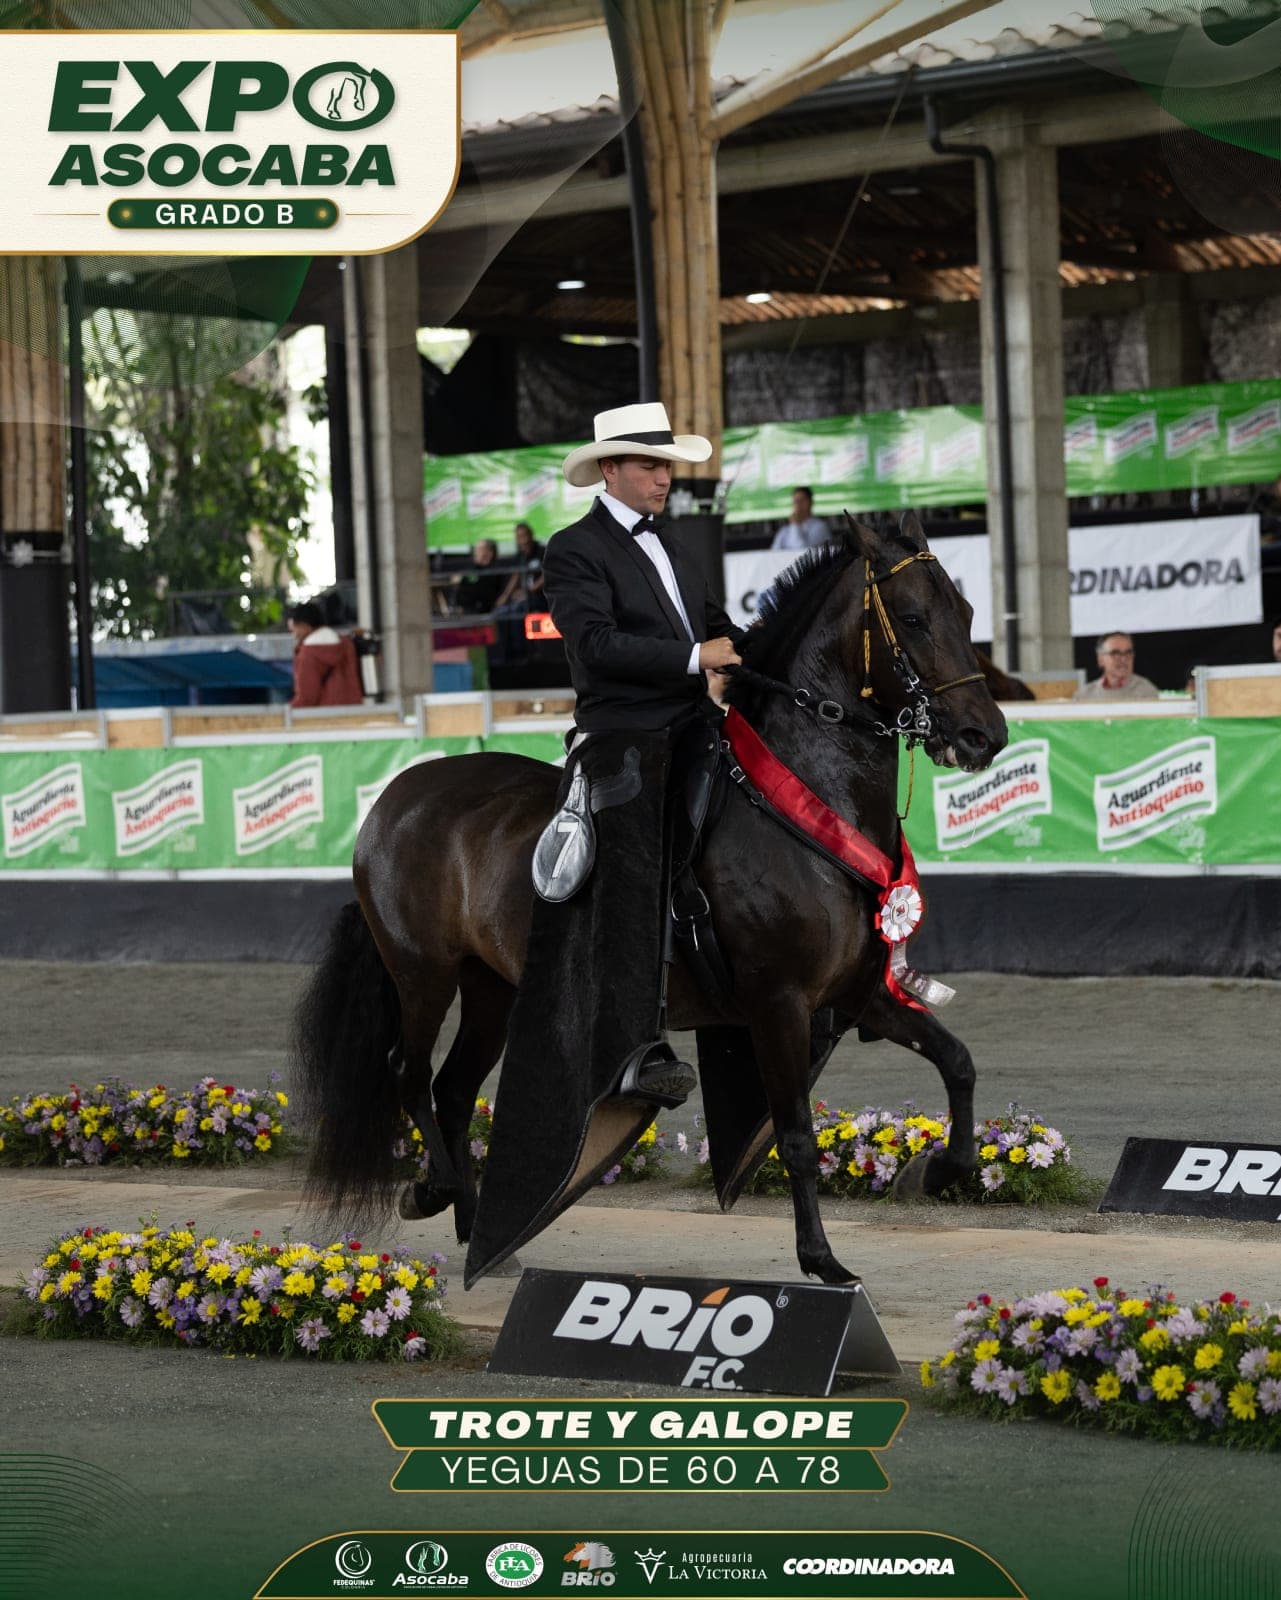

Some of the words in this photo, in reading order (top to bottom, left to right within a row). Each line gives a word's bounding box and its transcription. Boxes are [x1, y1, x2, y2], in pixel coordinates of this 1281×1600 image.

[947, 776, 1040, 830] Antioqueño
[948, 760, 1037, 810] Aguardiente
[1108, 760, 1203, 810] Aguardiente
[1108, 776, 1205, 829] Antioqueño
[552, 821, 580, 879] 7
[1162, 1146, 1281, 1197] BR
[681, 1356, 744, 1390] F.C.
